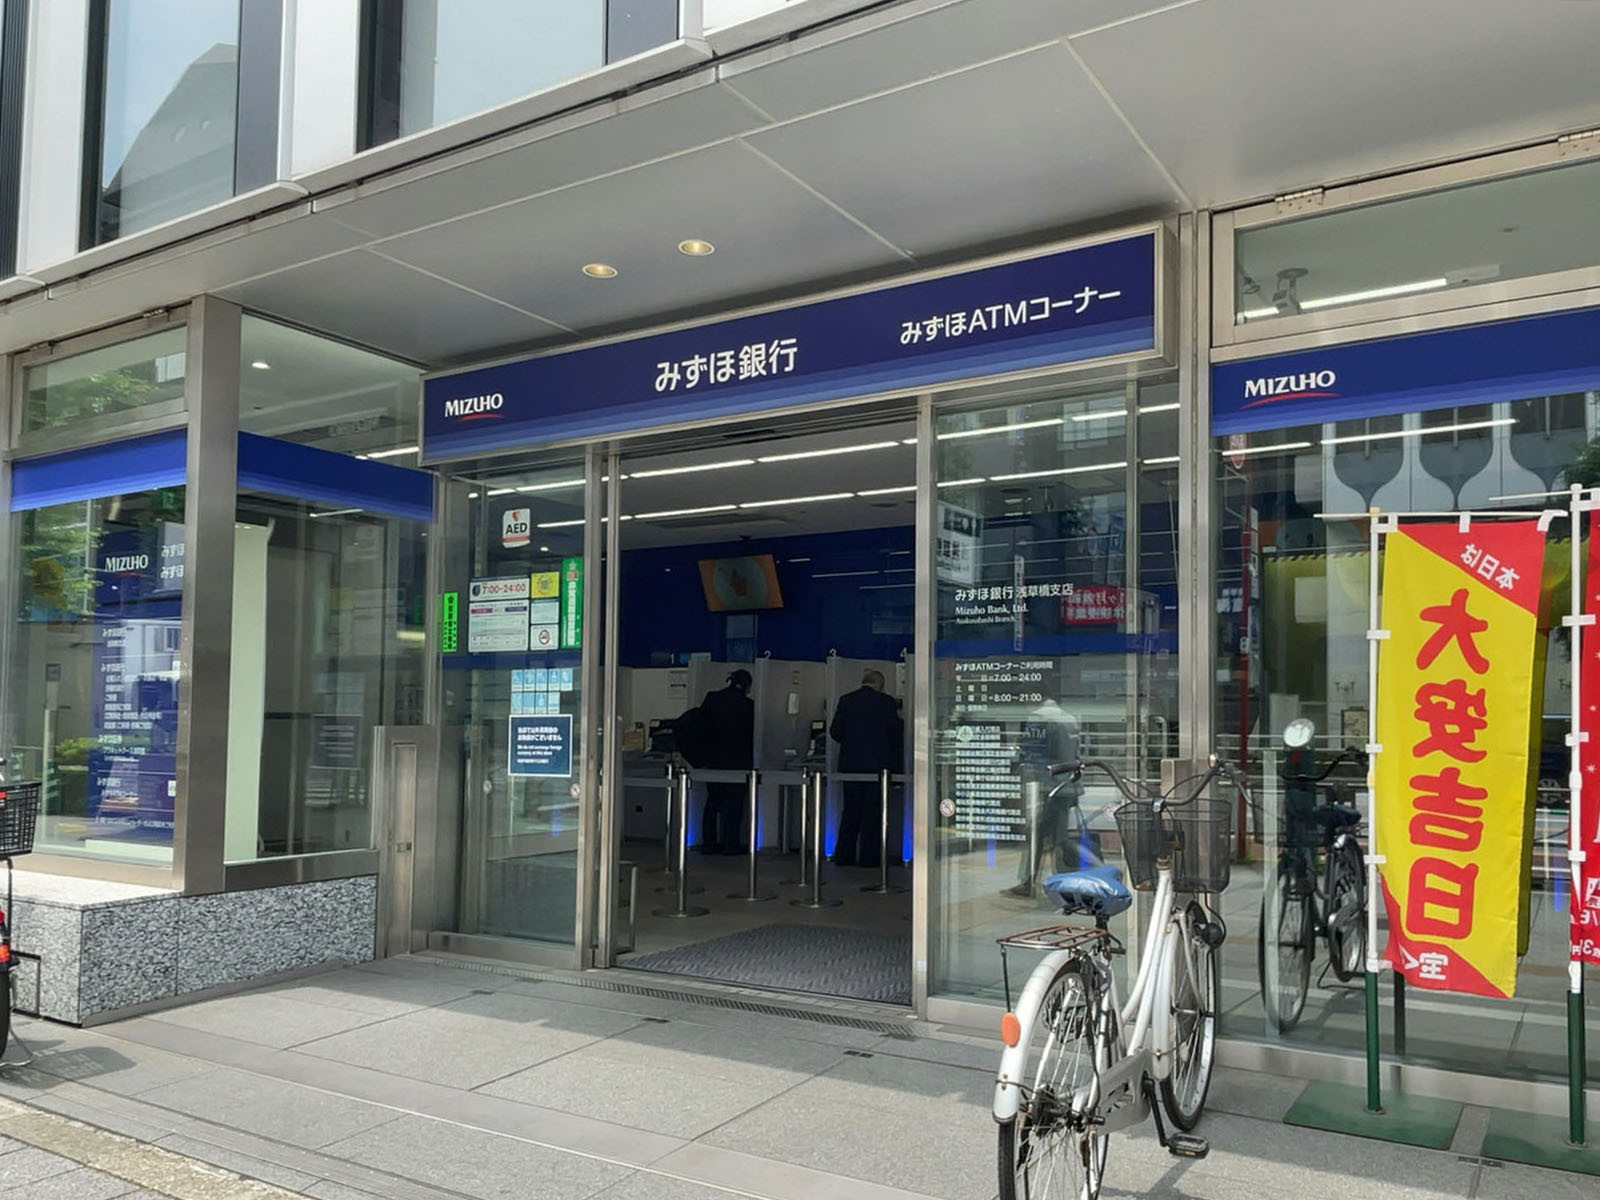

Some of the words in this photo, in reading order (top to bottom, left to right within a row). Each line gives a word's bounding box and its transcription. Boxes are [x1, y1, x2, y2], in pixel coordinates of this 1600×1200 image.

[899, 286, 1122, 347] みずほATMコーナー
[654, 337, 799, 393] みずほ銀行
[1244, 370, 1336, 398] MIZUHO
[444, 393, 504, 418] MIZUHO
[505, 522, 528, 534] AED
[104, 554, 149, 572] MIZUHO
[955, 586, 1014, 601] みずほ銀行
[1016, 583, 1073, 599] 浅草橋支店
[955, 605, 985, 616] Mizuho
[987, 604, 1010, 615] Bank,
[1012, 603, 1029, 613] Ltd.
